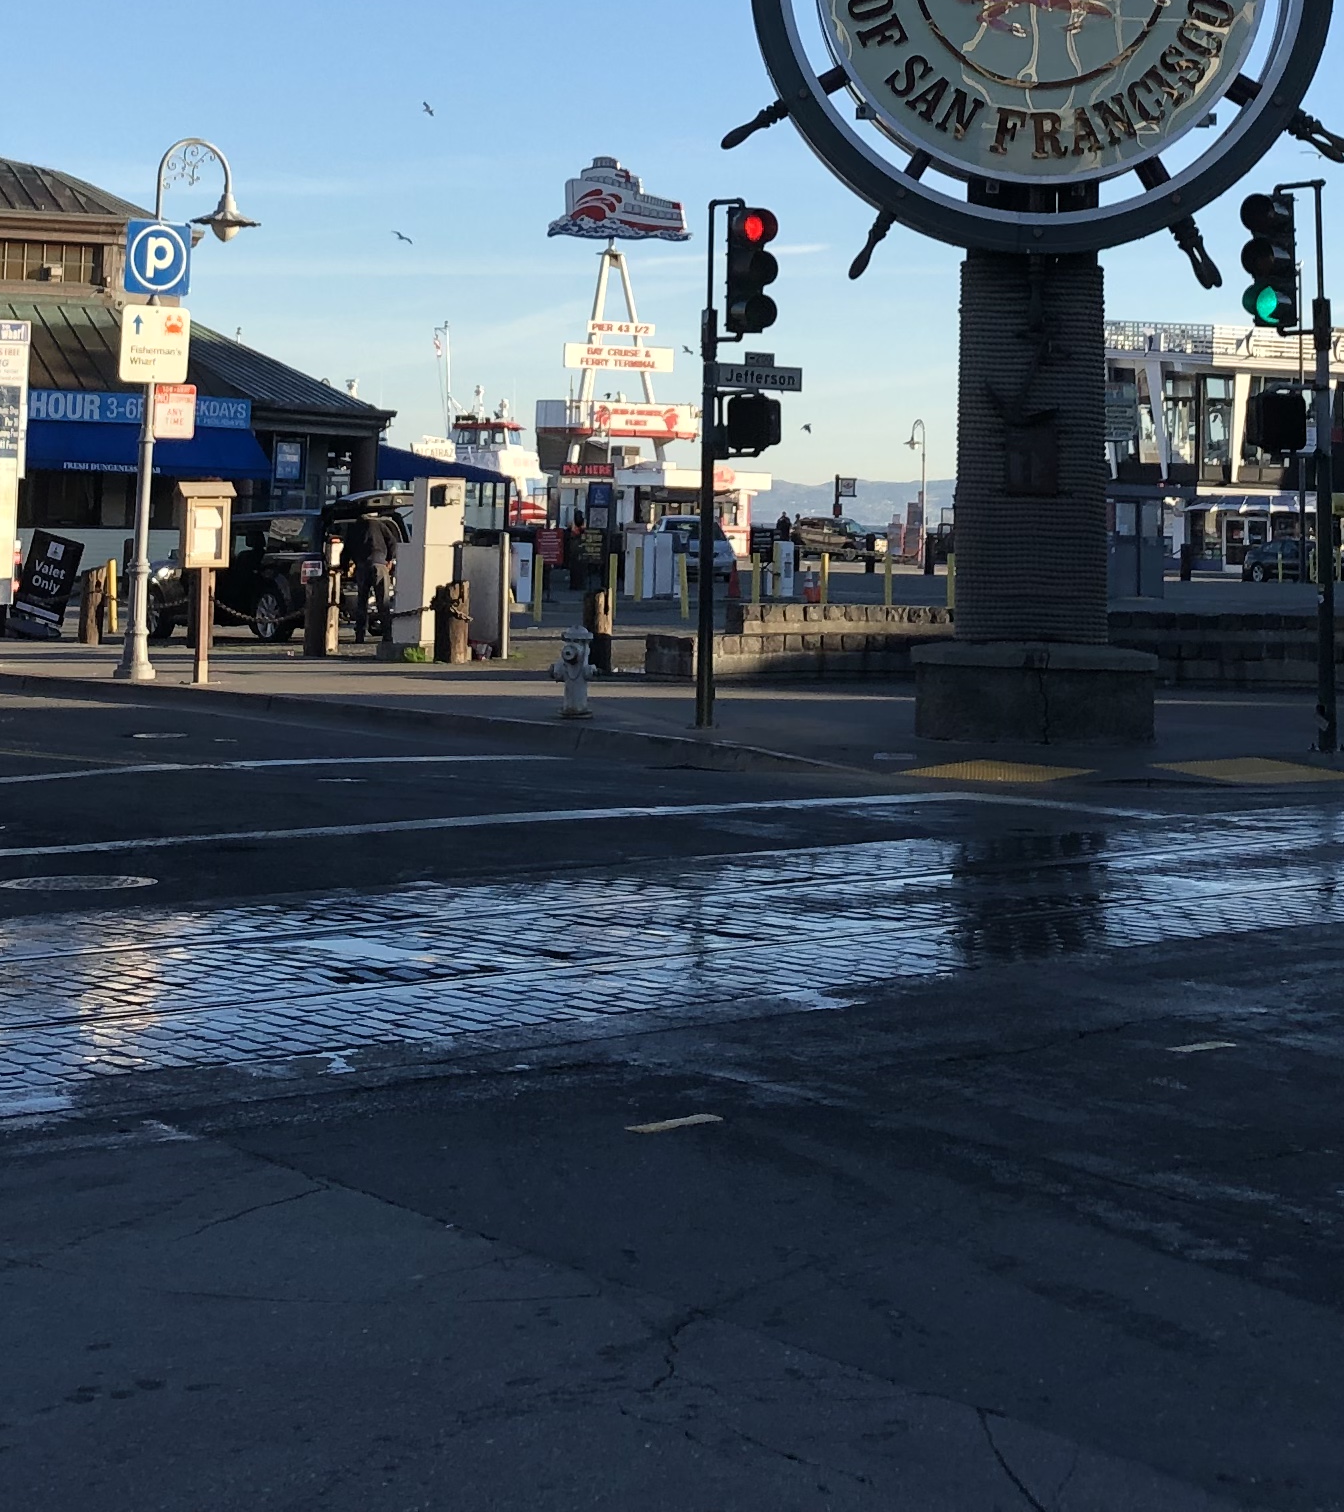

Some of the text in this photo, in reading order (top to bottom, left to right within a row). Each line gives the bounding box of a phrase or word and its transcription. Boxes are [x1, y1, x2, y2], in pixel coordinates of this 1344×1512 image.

[884, 54, 985, 140] SAN
[591, 323, 613, 332] PIER
[617, 324, 630, 333] 43
[130, 345, 182, 356] Fisherman's
[607, 348, 640, 357] CRUISE
[129, 356, 157, 366] Wharf
[580, 357, 609, 367] FERRY
[725, 368, 796, 386] Jefferson
[157, 394, 169, 403] NO
[29, 391, 102, 420] HOUR
[166, 407, 184, 417] ANY
[165, 417, 185, 426] TIME
[62, 461, 89, 471] FRESH
[90, 462, 138, 474] DUNGENESS
[562, 464, 612, 476] PAY HERE
[35, 559, 66, 580] Valet
[31, 574, 61, 595] Only
